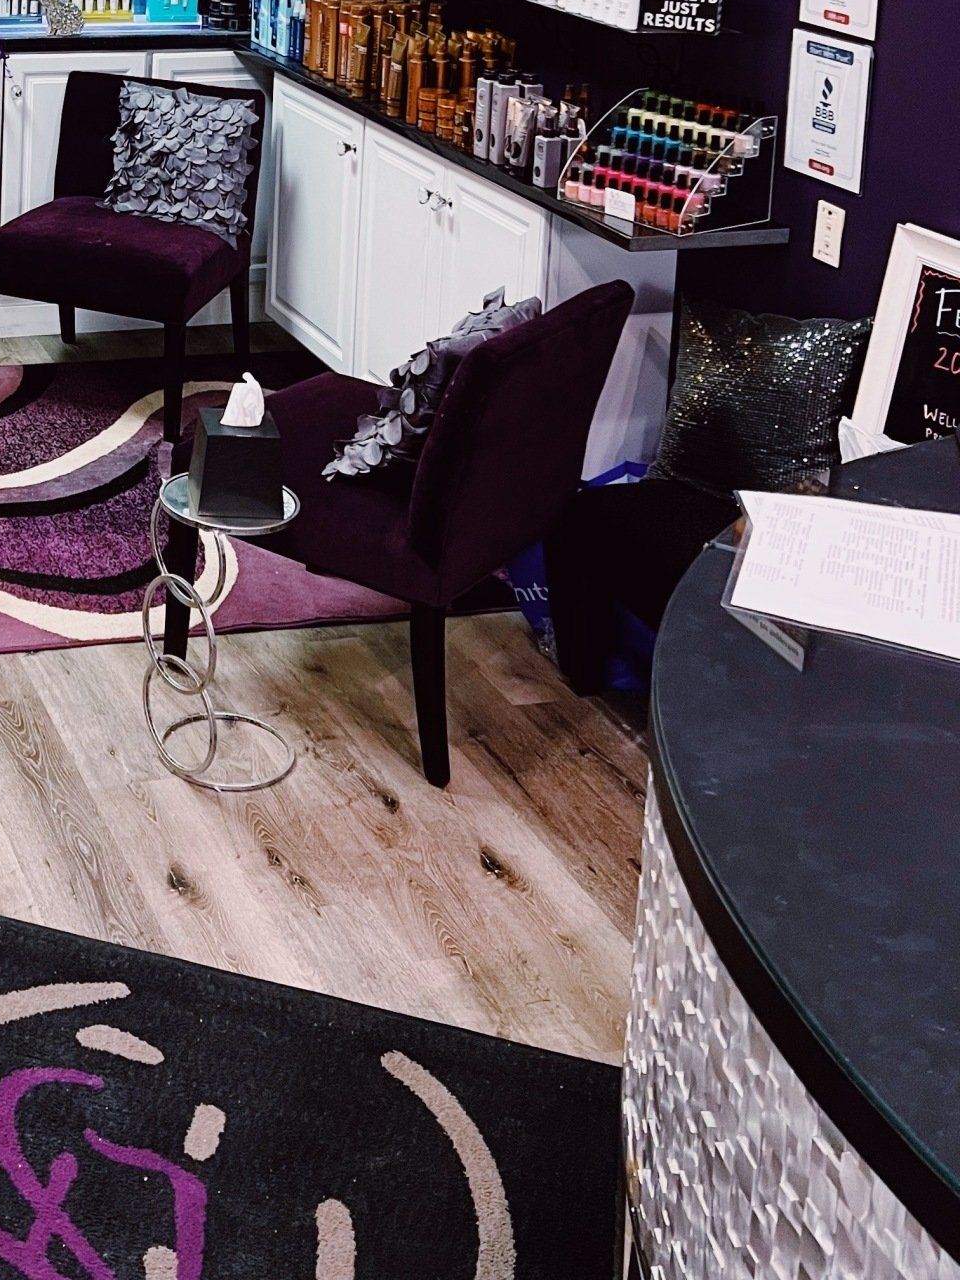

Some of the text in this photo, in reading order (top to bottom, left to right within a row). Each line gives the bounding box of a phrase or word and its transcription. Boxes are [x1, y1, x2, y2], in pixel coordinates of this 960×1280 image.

[660, 0, 700, 16] JUST
[643, 12, 716, 33] RESULTS
[815, 106, 835, 121] BBB
